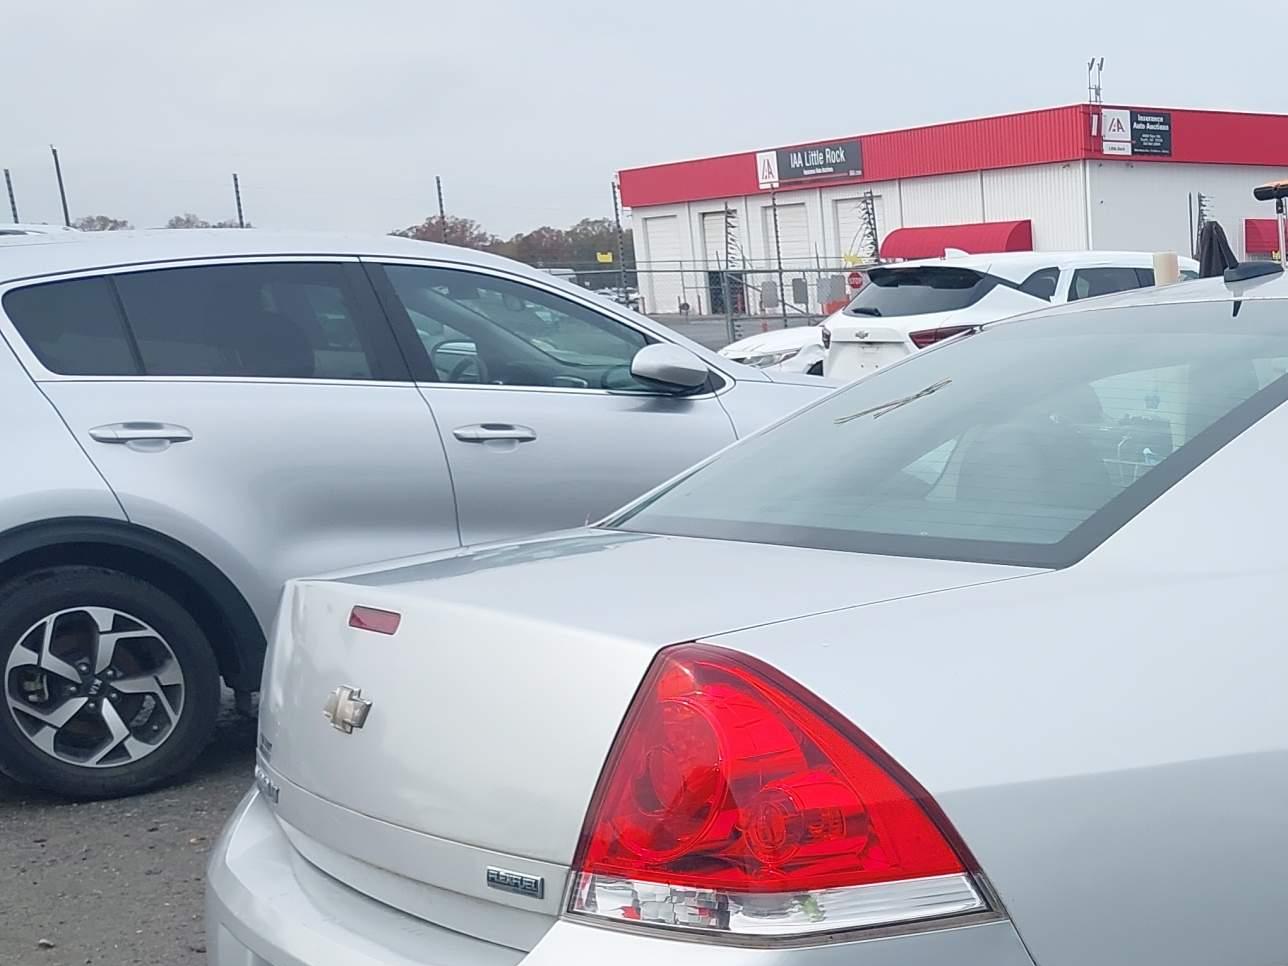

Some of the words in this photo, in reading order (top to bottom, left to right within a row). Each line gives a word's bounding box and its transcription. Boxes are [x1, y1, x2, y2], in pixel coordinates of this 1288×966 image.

[790, 151, 804, 169] IAA
[804, 149, 824, 167] Little
[825, 146, 846, 164] Rock
